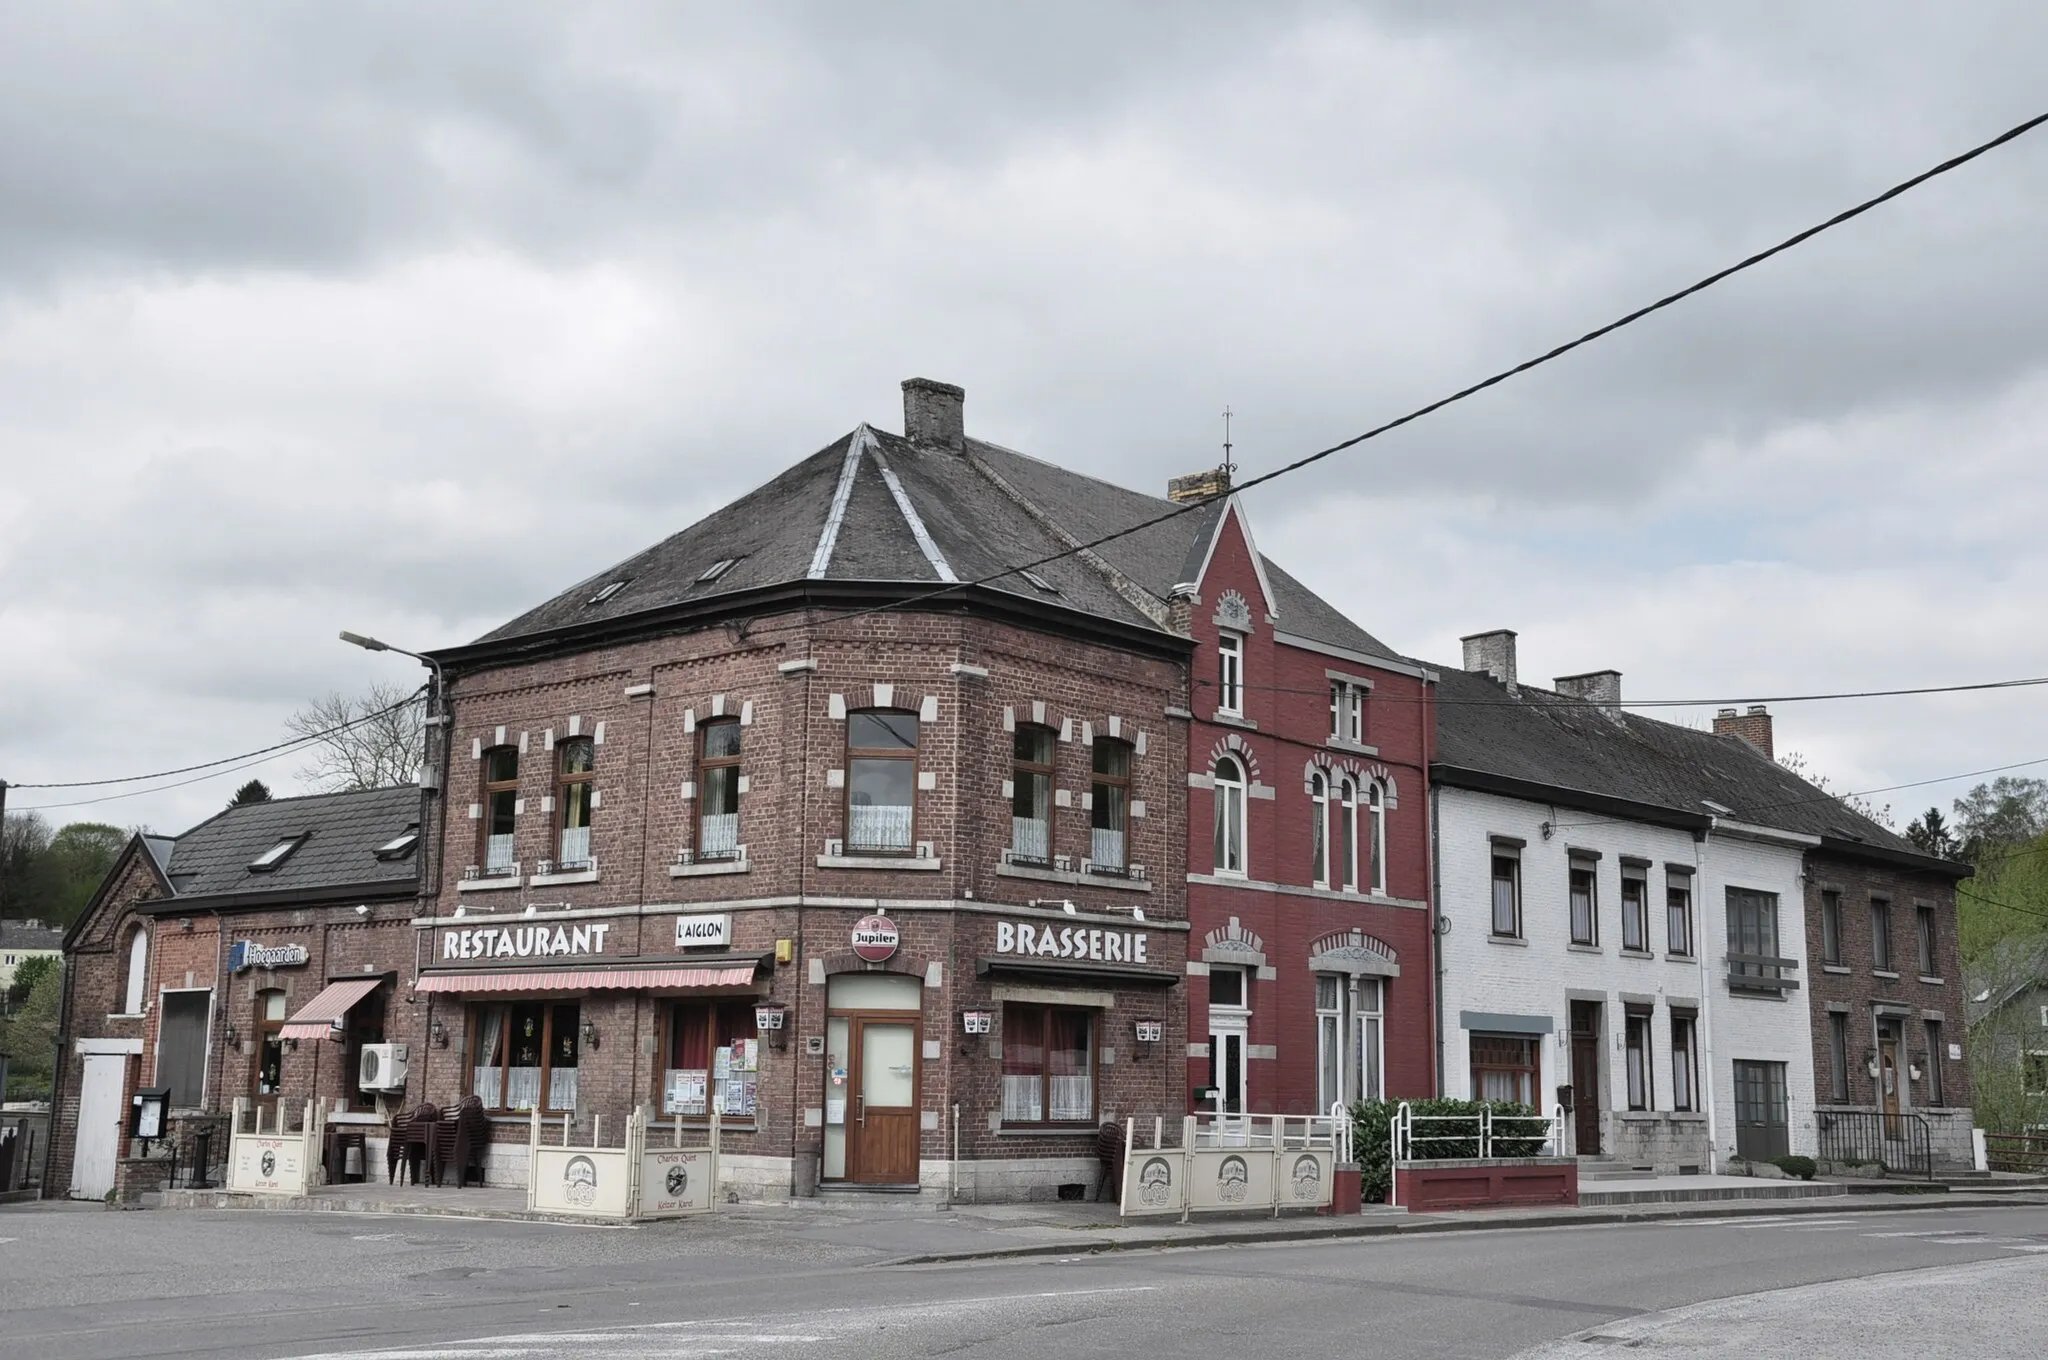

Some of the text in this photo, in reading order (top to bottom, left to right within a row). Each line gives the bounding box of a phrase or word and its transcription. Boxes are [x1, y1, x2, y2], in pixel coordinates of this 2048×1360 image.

[678, 922, 722, 938] L'AIGLON
[855, 932, 896, 944] Jupiler
[443, 924, 609, 959] RESTAURANT
[996, 921, 1147, 964] BRASSERIE
[248, 945, 300, 967] Hoegaarden
